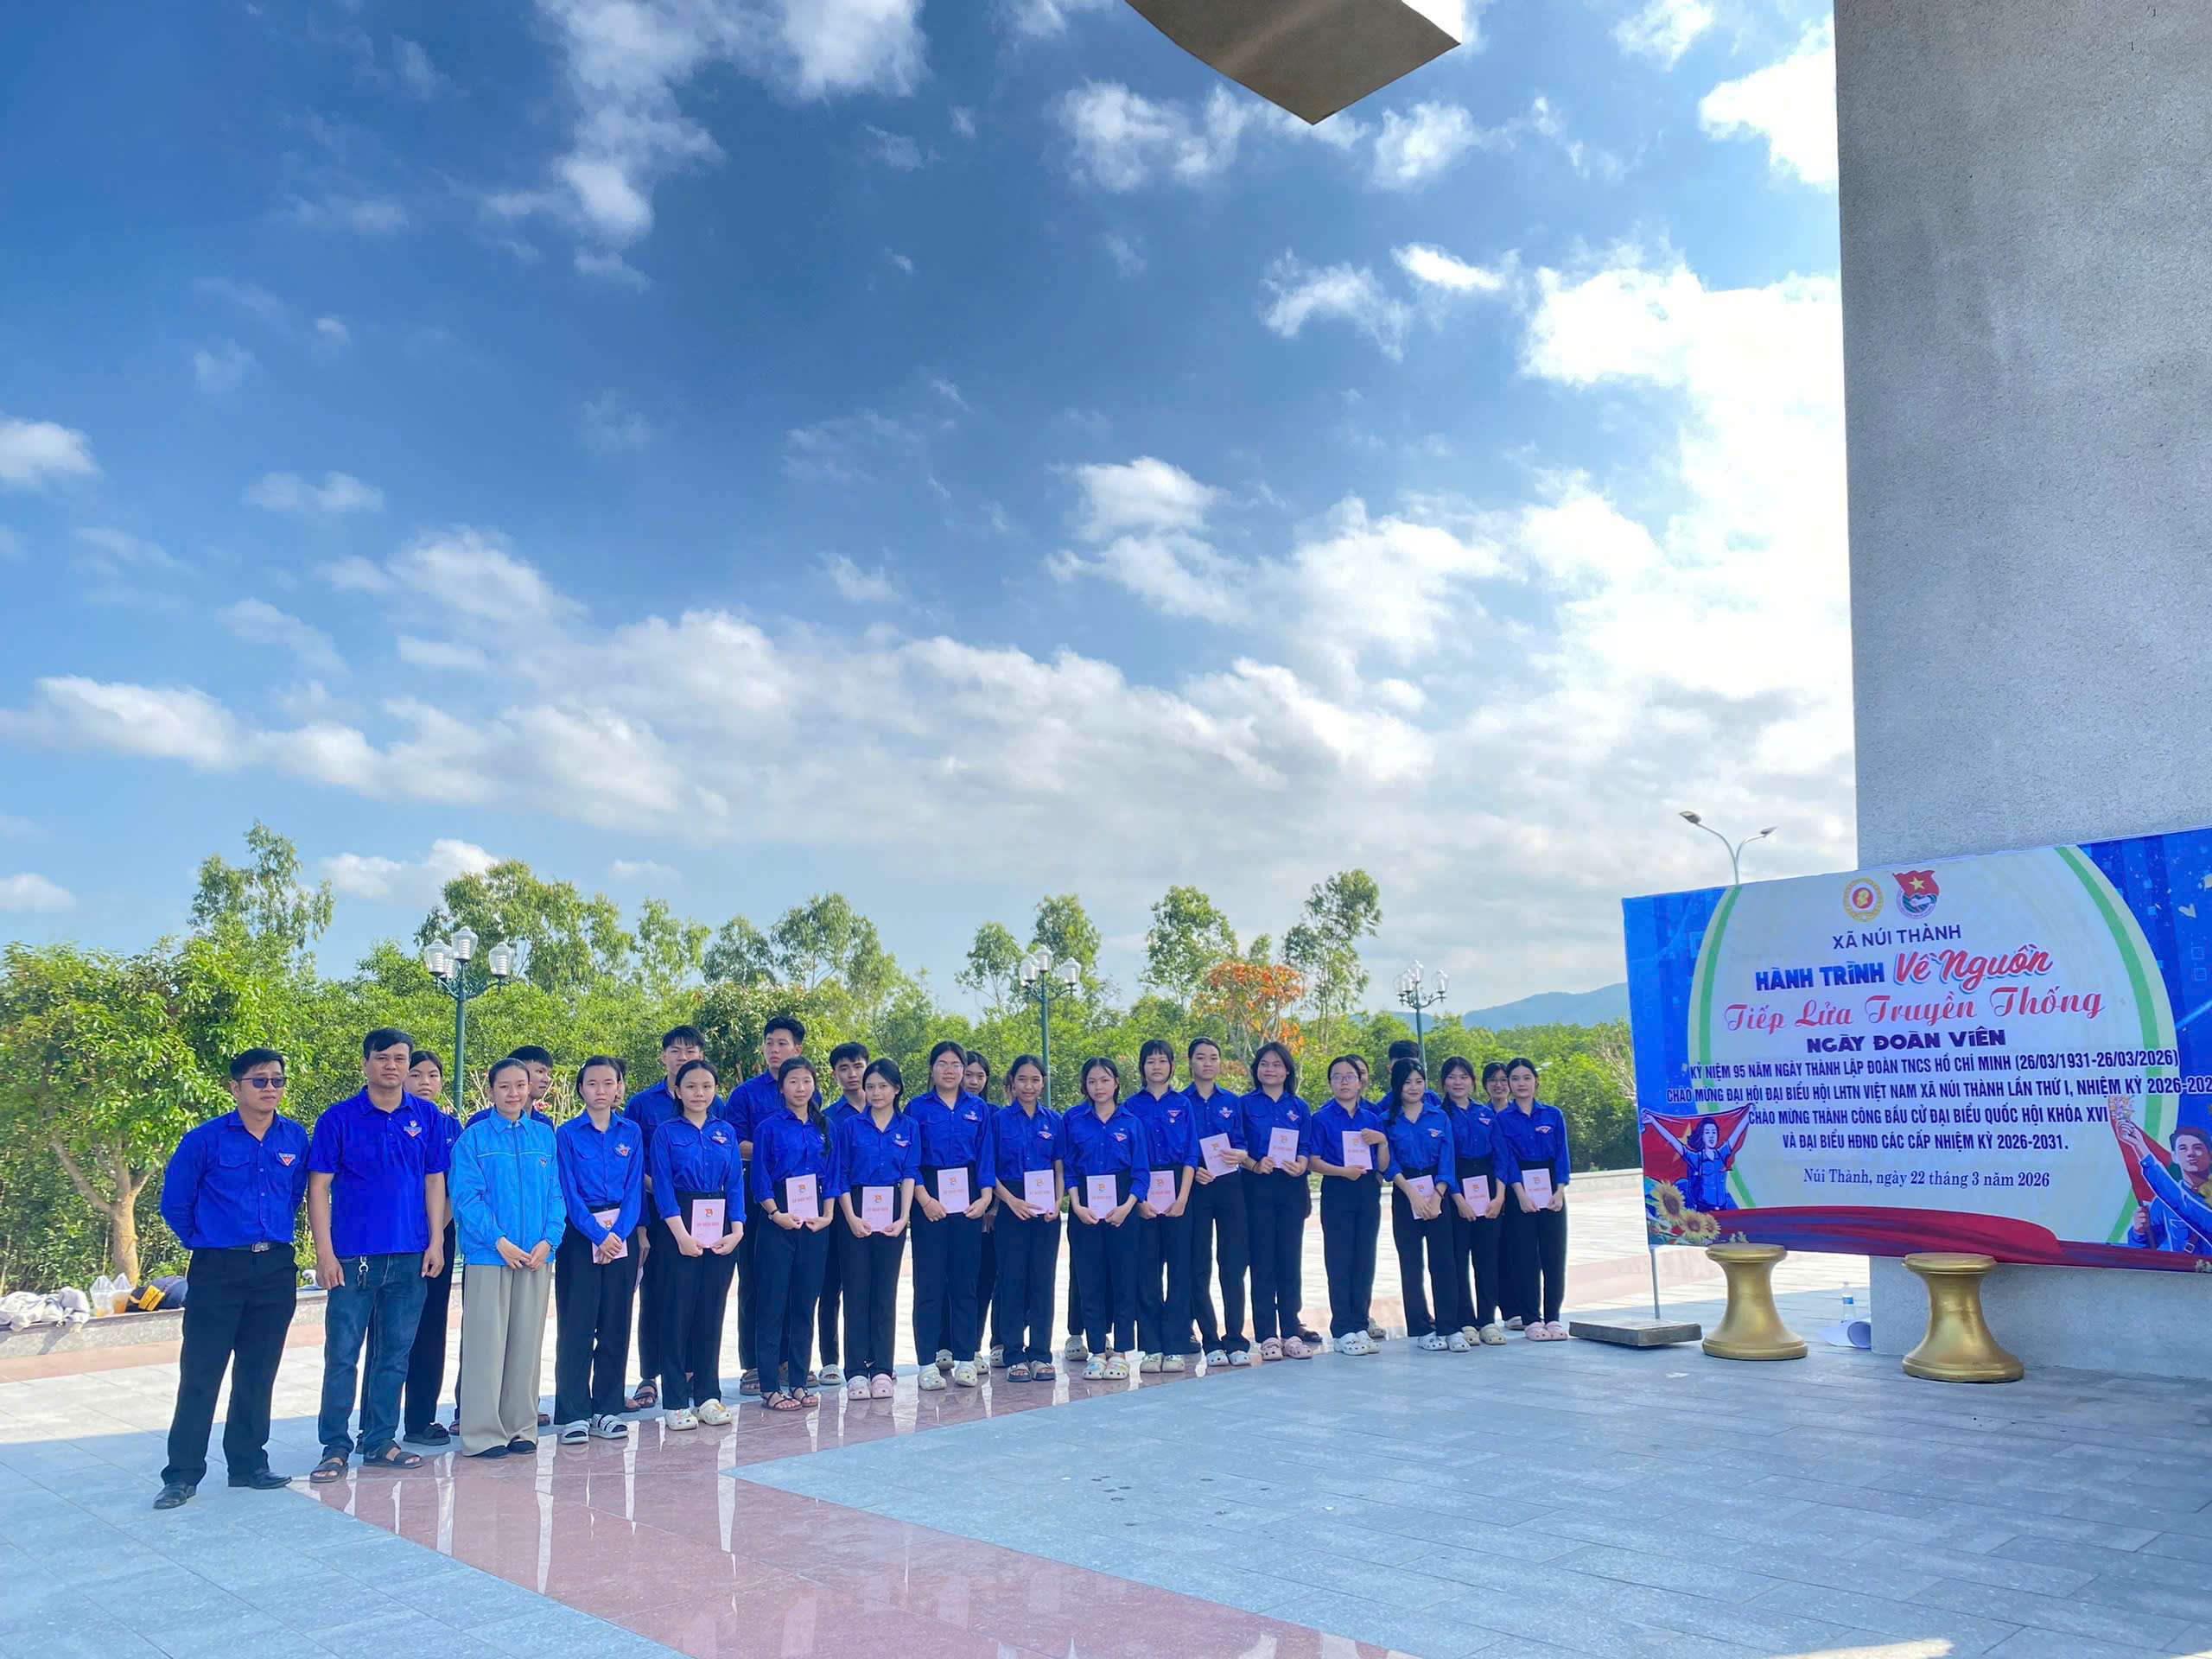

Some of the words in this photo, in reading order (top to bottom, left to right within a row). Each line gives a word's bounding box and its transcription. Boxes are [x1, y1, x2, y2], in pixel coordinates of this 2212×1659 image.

[1832, 930, 1858, 950] XÃ
[1862, 927, 1892, 947] NÚI
[1896, 922, 1961, 944] THÀNH
[1755, 967, 1814, 991] HÀNH
[1894, 950, 1938, 984] Về
[1938, 944, 2053, 992] Nguồn
[1725, 1003, 1786, 1034] Tiếp
[1794, 999, 1854, 1027] Lửa
[1865, 991, 1977, 1027] Truyền
[1990, 985, 2106, 1019] Thống
[1807, 1033, 1866, 1053] NGÀY
[1873, 1030, 1941, 1051] ĐOÀN
[1705, 1062, 1730, 1082] NIỆM
[1733, 1065, 1745, 1077] 95
[1748, 1061, 1771, 1077] NĂM
[1775, 1060, 1802, 1077] NGÀY
[1806, 1058, 1840, 1076] THÀNH
[1843, 1058, 1864, 1078] LẬP
[1867, 1057, 1898, 1074] ĐOÀN
[1901, 1058, 1931, 1073] TNCS
[1935, 1052, 1951, 1072] HỒ
[1955, 1053, 1974, 1071] CHÍ
[1978, 1055, 2012, 1071] MINH
[2015, 1049, 2179, 1071] (26/03/1931-26/03/2026)
[1667, 1085, 1692, 1103] CHÀO
[1695, 1084, 1724, 1102] MỪNG
[1727, 1088, 1744, 1104] ĐẠI
[1746, 1084, 1763, 1104] HỘI
[1765, 1087, 1783, 1103] ĐẠI
[1786, 1081, 1809, 1100] BIỂU
[1813, 1084, 1831, 1103] HỘI
[1834, 1085, 1860, 1100] LHTN
[1863, 1082, 1887, 1102] VIỆT
[1891, 1084, 1916, 1098] NAM
[1920, 1081, 1936, 1098] XÃ
[1939, 1079, 1961, 1097] NÚI
[1963, 1079, 2005, 1096] THÀNH
[2007, 1076, 2031, 1096] LẦN
[2036, 1077, 2061, 1096] THỨ
[2064, 1080, 2074, 1097] I,
[2076, 1076, 2121, 1098] NHIỆM
[2125, 1074, 2142, 1094] KỲ
[1748, 1107, 1775, 1124] CHÀO
[1778, 1107, 1809, 1124] MỪNG
[1812, 1107, 1848, 1124] THÀNH
[1851, 1106, 1882, 1124] CÔNG
[1885, 1103, 1907, 1123] BẦU
[1910, 1103, 1927, 1123] CỬ
[1929, 1109, 1950, 1127] ĐẠI
[1954, 1102, 1980, 1123] BIỂU
[1985, 1102, 2018, 1124] QUỐC
[2022, 1104, 2043, 1126] HỘI
[2047, 1103, 2083, 1122] KHÓA
[2088, 1106, 2108, 1122] XVI
[1783, 1131, 1796, 1148] VÀ
[1800, 1135, 1816, 1152] ĐẠI
[1821, 1128, 1844, 1148] BIỂU
[1848, 1134, 1878, 1149] HĐND
[1882, 1131, 1904, 1149] CÁC
[1908, 1128, 1931, 1149] CẤP
[1935, 1131, 1974, 1153] NHIỆM
[1977, 1131, 1993, 1149] KỲ
[1997, 1134, 2069, 1149] 2026-2031.
[1803, 1168, 1825, 1183] Núi
[1828, 1168, 1872, 1185] Thành,
[1876, 1170, 1907, 1187] ngày
[1910, 1170, 1925, 1185] 22
[1929, 1170, 1968, 1189] tháng
[1972, 1171, 1980, 1185] 3
[1983, 1173, 2014, 1186] năm
[2018, 1172, 2050, 1187] 2026
